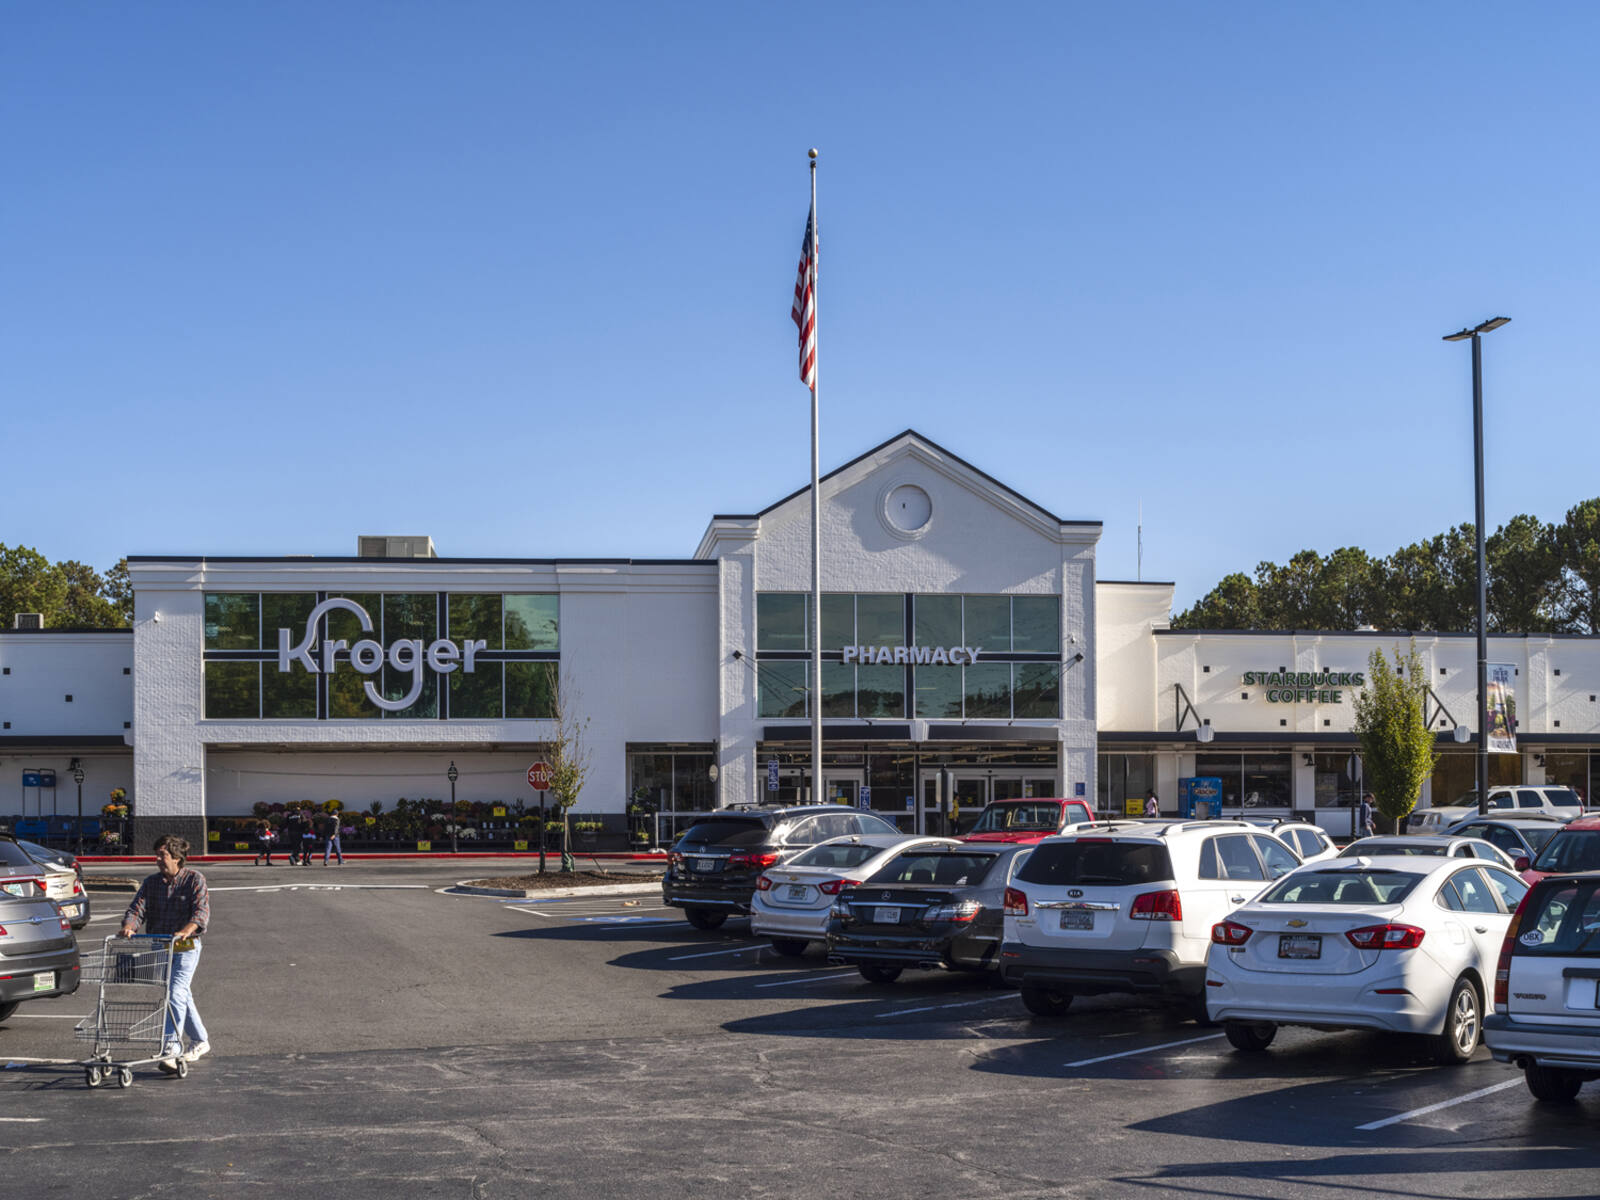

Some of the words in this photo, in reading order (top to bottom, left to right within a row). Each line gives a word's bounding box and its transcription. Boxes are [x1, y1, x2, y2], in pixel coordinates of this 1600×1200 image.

[843, 645, 982, 664] PHARMACY
[1243, 671, 1365, 686] STARBUCKS
[1266, 689, 1343, 704] COFFEE
[529, 770, 554, 782] STOP
